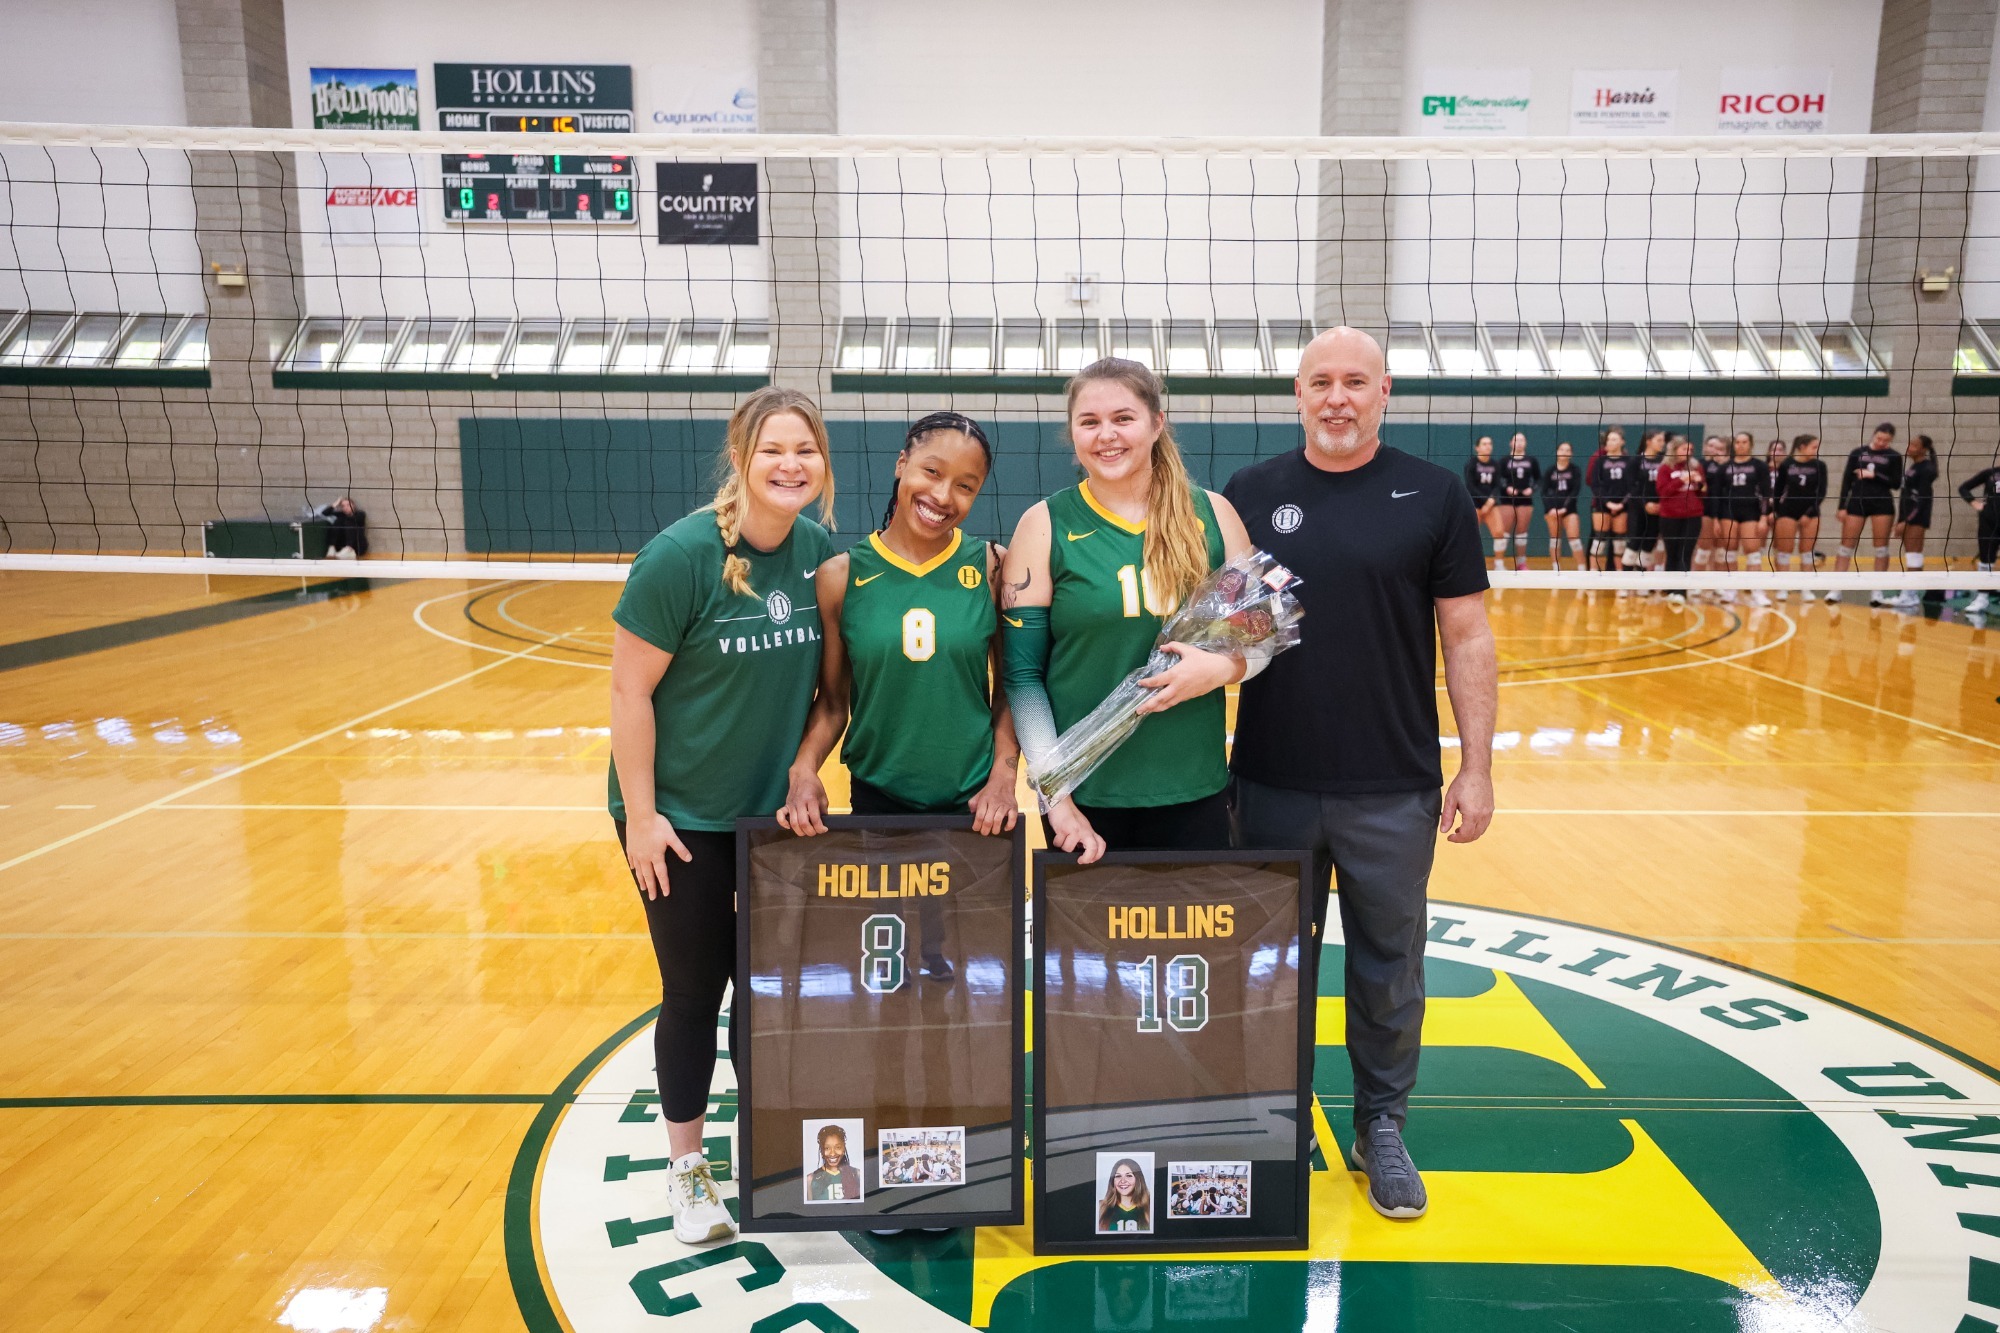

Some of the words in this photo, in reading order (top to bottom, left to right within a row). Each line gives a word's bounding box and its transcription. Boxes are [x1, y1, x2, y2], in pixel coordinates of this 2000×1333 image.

[470, 69, 596, 95] HOLLINS
[472, 95, 595, 104] UNIVERSITY
[1594, 86, 1656, 107] Harris
[1720, 94, 1824, 114] RICOH
[445, 114, 481, 128] HOME
[583, 115, 630, 130] VISITOR
[460, 161, 490, 173] BONUS
[512, 155, 545, 167] PERIOD
[445, 178, 474, 188] FOULS
[506, 178, 539, 188] PLAYER
[550, 178, 577, 189] FOULS
[601, 179, 629, 189] FOULS
[460, 188, 474, 209] 0
[487, 194, 499, 210] 2
[577, 194, 590, 211] 2
[615, 189, 629, 211] 0
[659, 195, 756, 213] COUNTRY
[961, 568, 979, 586] H
[719, 625, 821, 654] VOLLEYBA
[902, 608, 936, 662] 8
[817, 861, 950, 898] HOLLINS
[1108, 904, 1235, 940] HOLLINS
[860, 913, 906, 994] 8
[1426, 915, 1810, 1031] LLINS
[1136, 954, 1209, 1033] 18
